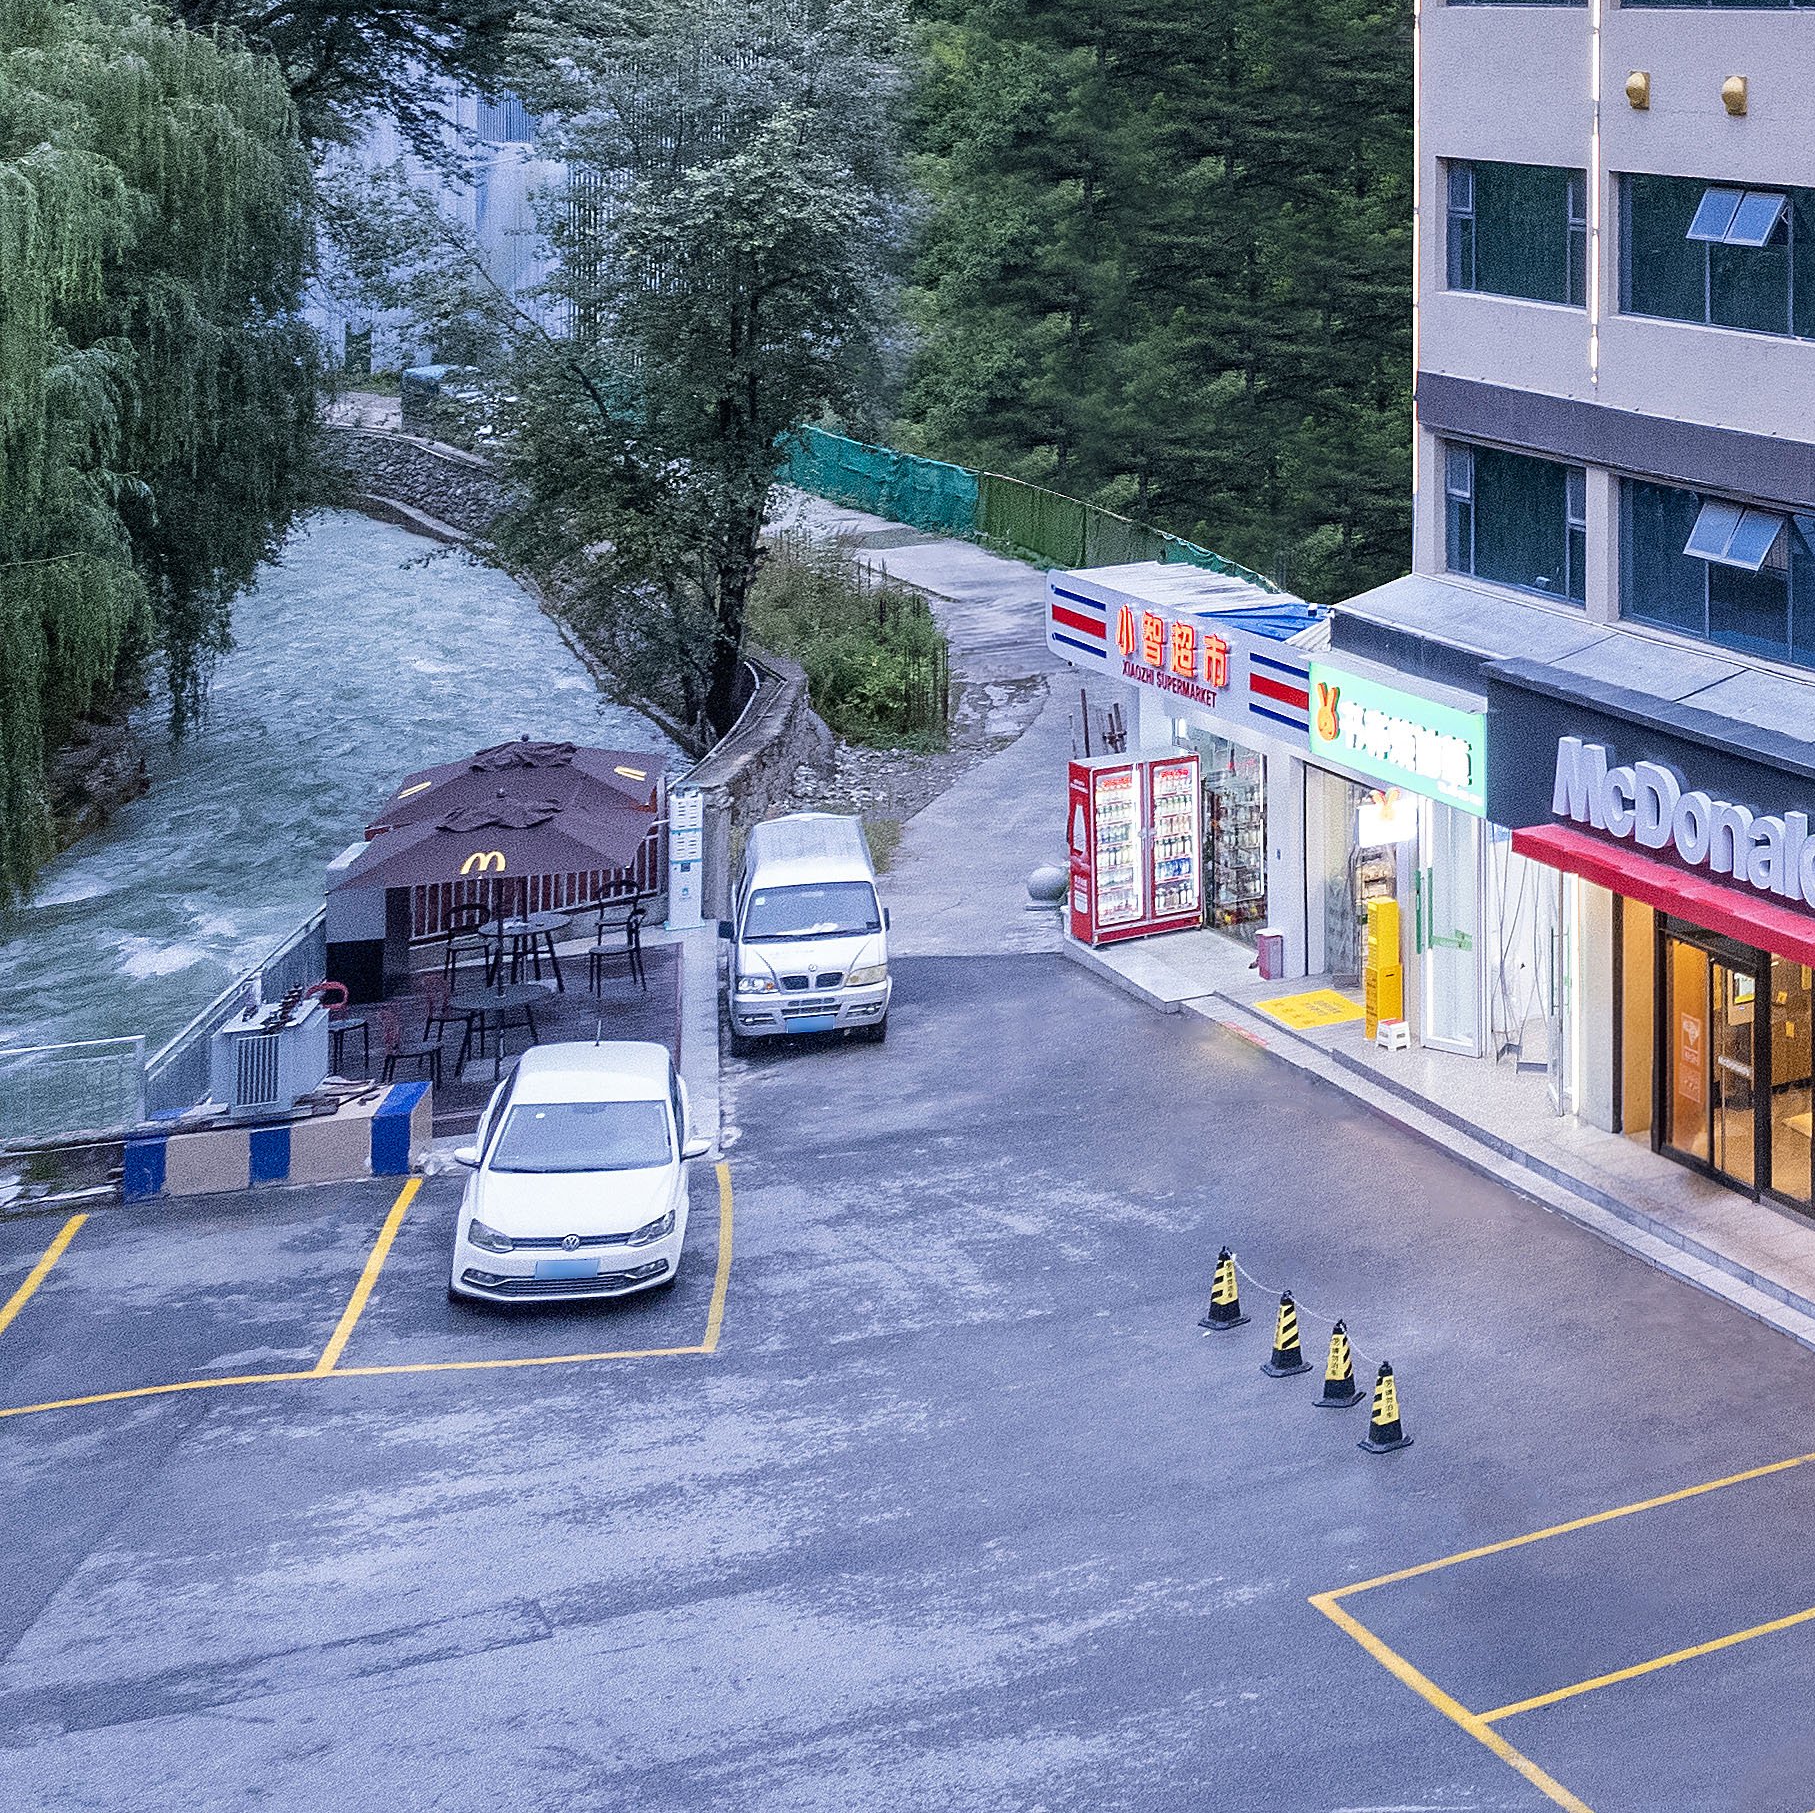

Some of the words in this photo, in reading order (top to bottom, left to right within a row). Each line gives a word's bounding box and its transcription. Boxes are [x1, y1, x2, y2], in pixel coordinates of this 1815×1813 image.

[1115, 603, 1230, 689] 小智超市
[1122, 659, 1155, 686] XIAOZHI
[1156, 670, 1218, 709] SUPERMARKET
